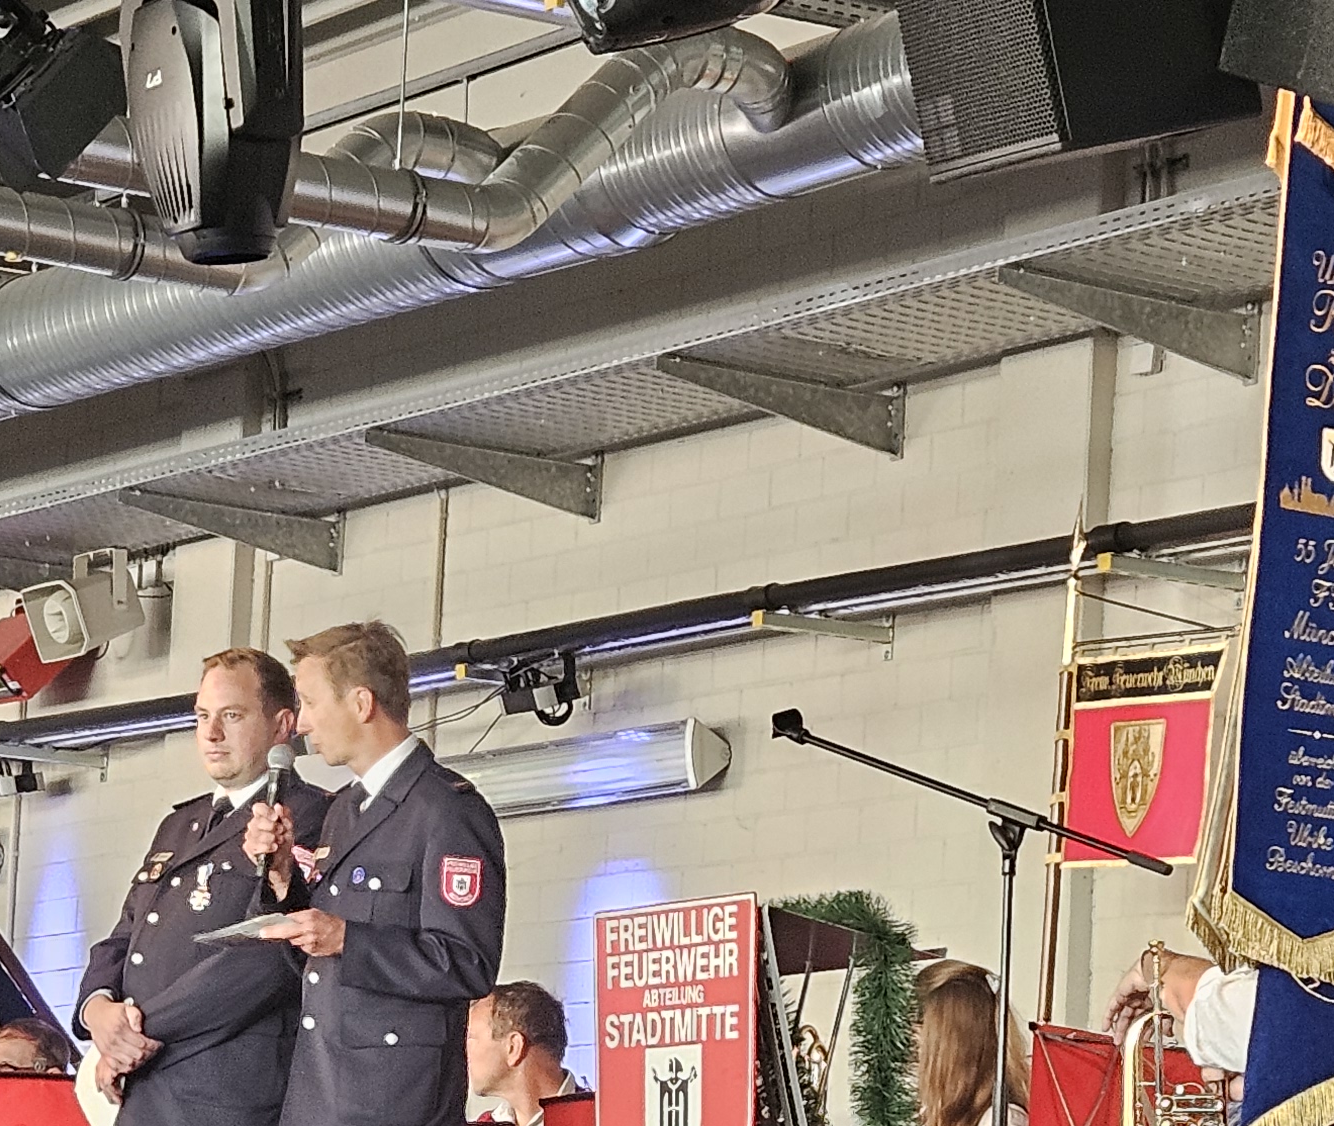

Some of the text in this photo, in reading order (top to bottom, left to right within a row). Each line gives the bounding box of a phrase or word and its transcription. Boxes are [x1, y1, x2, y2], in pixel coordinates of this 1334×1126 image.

[1294, 538, 1316, 563] 55
[605, 904, 738, 953] FREIWILLIGE
[606, 942, 738, 989] FEUERWEHR
[642, 984, 704, 1008] ABTEILUNG
[605, 1005, 739, 1049] STADTMITTE
